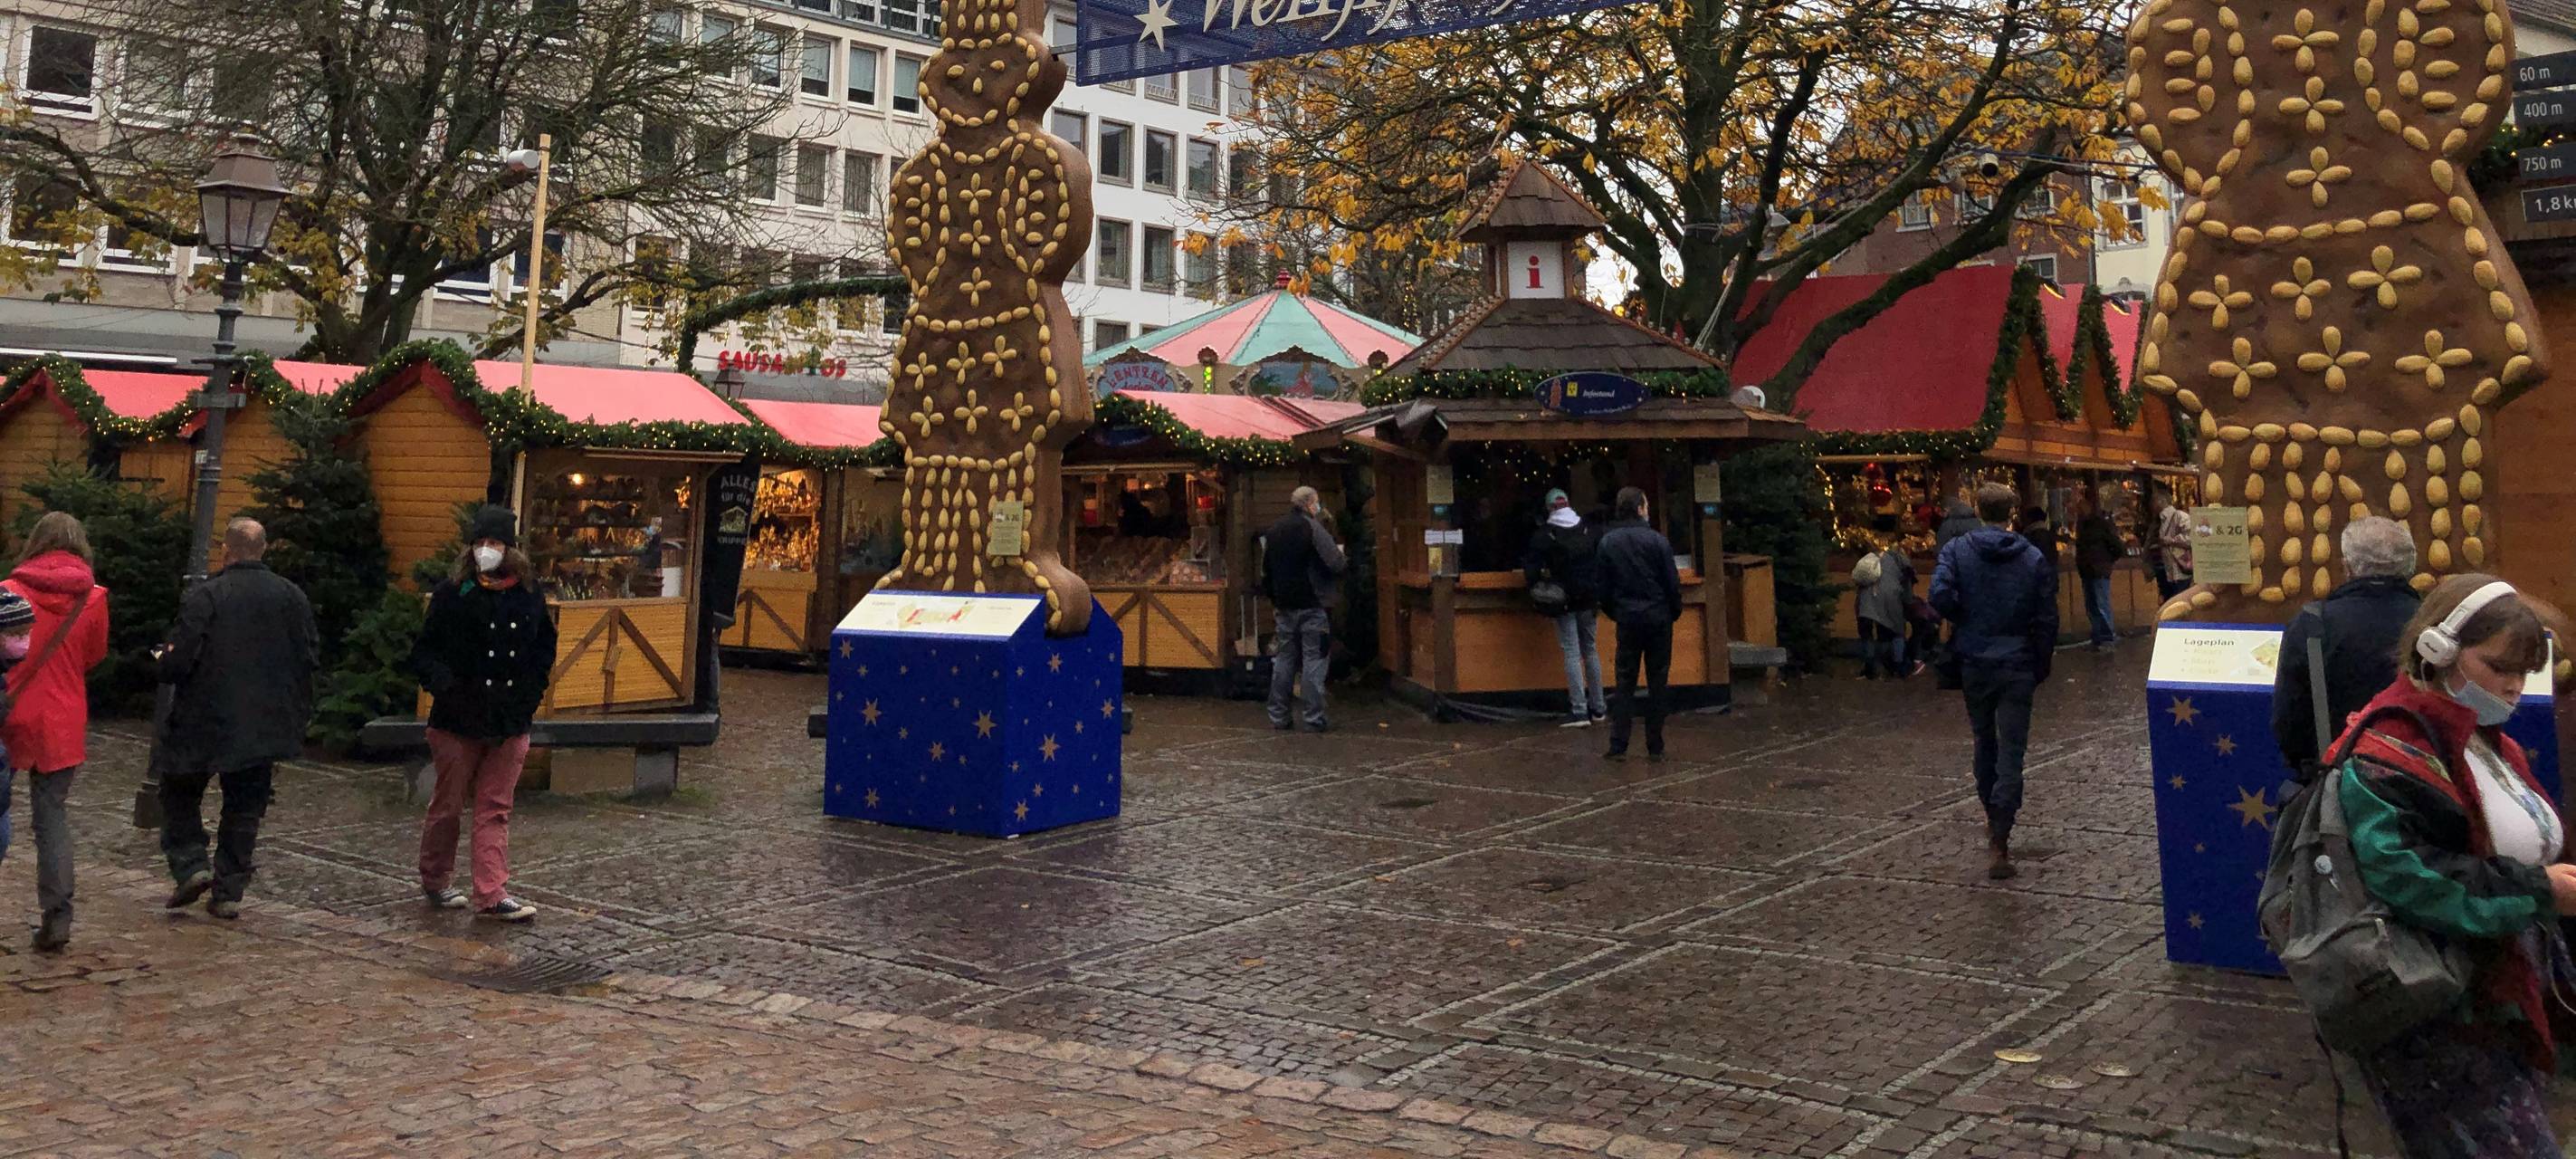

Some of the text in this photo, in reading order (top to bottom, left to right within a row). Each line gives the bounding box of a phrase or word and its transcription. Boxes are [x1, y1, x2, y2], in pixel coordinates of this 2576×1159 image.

[2519, 66, 2551, 81] 60 m
[2524, 101, 2563, 118] 400 m
[2524, 156, 2562, 172] 750 m
[2534, 196, 2561, 214] 1,8
[720, 474, 757, 493] ALLES
[2228, 525, 2243, 535] 2G
[2183, 637, 2235, 647] Lageplan
